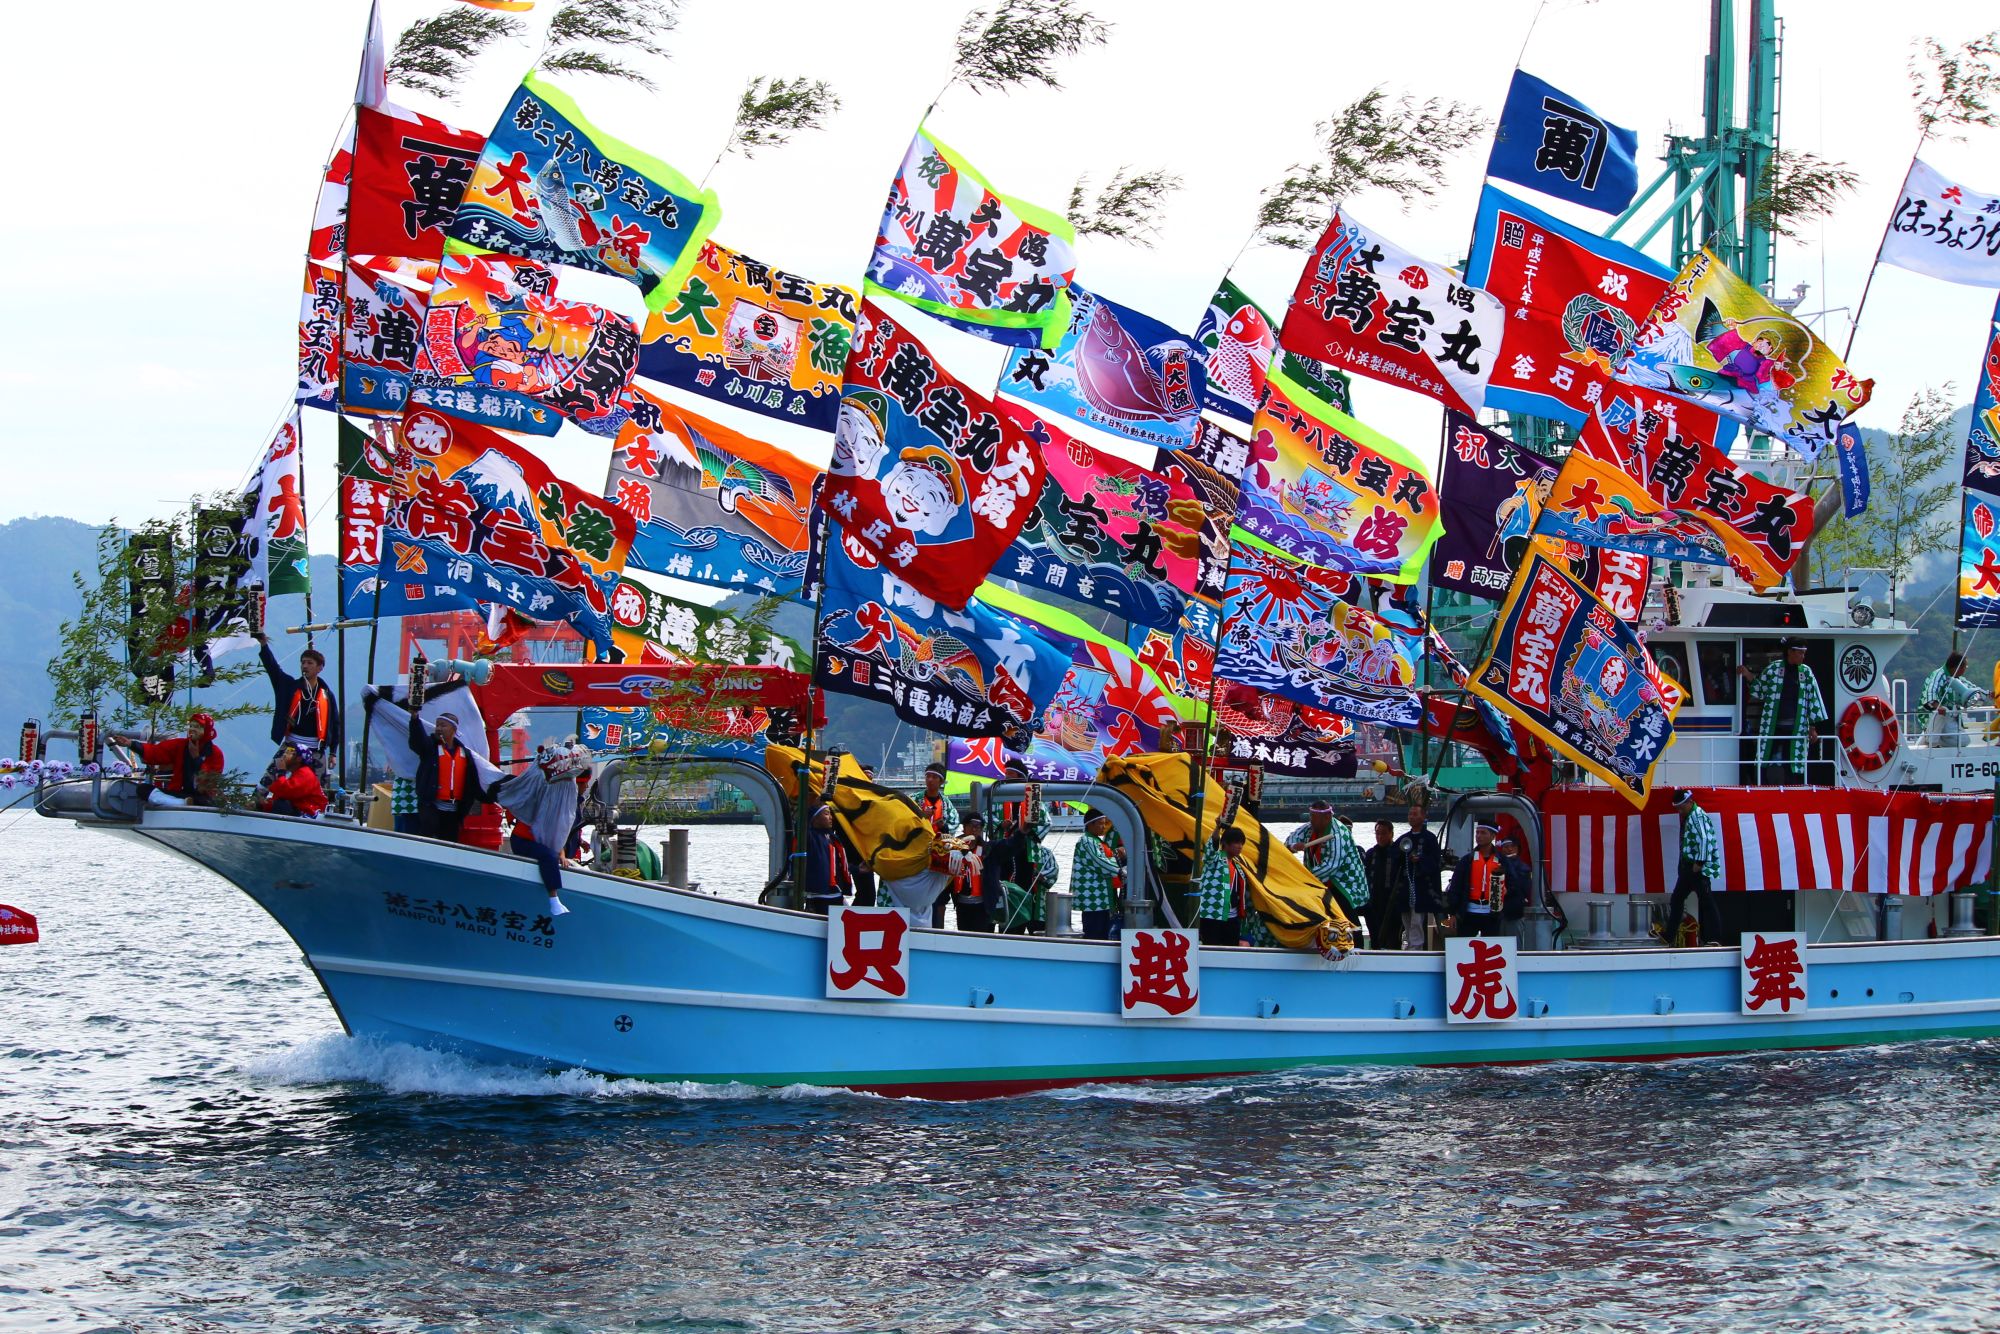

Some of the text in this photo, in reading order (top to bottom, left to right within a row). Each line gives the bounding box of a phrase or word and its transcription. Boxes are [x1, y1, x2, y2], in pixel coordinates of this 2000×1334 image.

[514, 97, 679, 229] 第二十八萬宝丸
[917, 150, 950, 189] 祝
[1535, 116, 1594, 181] 萬
[1941, 185, 1963, 205] 大
[913, 210, 1056, 314] 萬宝丸
[1304, 254, 1337, 310] 第二十八
[1351, 244, 1384, 275] 大
[1514, 232, 1545, 321] 平成二十八年度
[374, 278, 406, 307] 祝
[664, 276, 719, 336] 大
[1598, 268, 1630, 301] 祝
[300, 279, 341, 385] 萬宝丸
[351, 297, 371, 362] 第二十八
[755, 316, 777, 338] 宝
[1069, 291, 1095, 336] 第二十八
[1323, 270, 1482, 375] 萬宝丸
[808, 316, 851, 376] 漁
[1012, 350, 1051, 391] 丸
[629, 391, 664, 435] 祝
[725, 378, 806, 415] 小川原泉
[880, 342, 1003, 475] 萬宝丸
[1600, 396, 1637, 434] 祝
[406, 416, 450, 455] 祝
[1090, 412, 1184, 446] 岩手日野自動車株式会社
[1453, 424, 1490, 470] 祝
[1623, 410, 1663, 474] 第二十八
[617, 434, 660, 527] 大漁
[1494, 444, 1526, 475] 大
[971, 440, 1035, 530] 大漁
[1561, 478, 1605, 524] 大
[1649, 435, 1798, 561] 萬宝丸
[345, 480, 375, 563] 第二十八
[829, 489, 919, 568] 林正男
[1353, 505, 1408, 560] 漁
[1014, 554, 1121, 609] 草間竜二
[1240, 577, 1256, 594] 祝
[1444, 560, 1465, 581] 贈
[1537, 568, 1576, 609] 第二十八
[613, 586, 642, 622] 祝
[1231, 596, 1256, 649] 大漁
[1588, 604, 1617, 638] 祝
[1512, 590, 1567, 704] 萬宝丸
[714, 677, 763, 691] UNIC
[1335, 700, 1402, 721] 多田建設株式会社
[382, 891, 556, 936] 第二十八萬宝丸
[387, 906, 447, 927] MANPOU
[455, 920, 497, 937] MARU
[829, 909, 1806, 1020] 只 越 虎 舞
